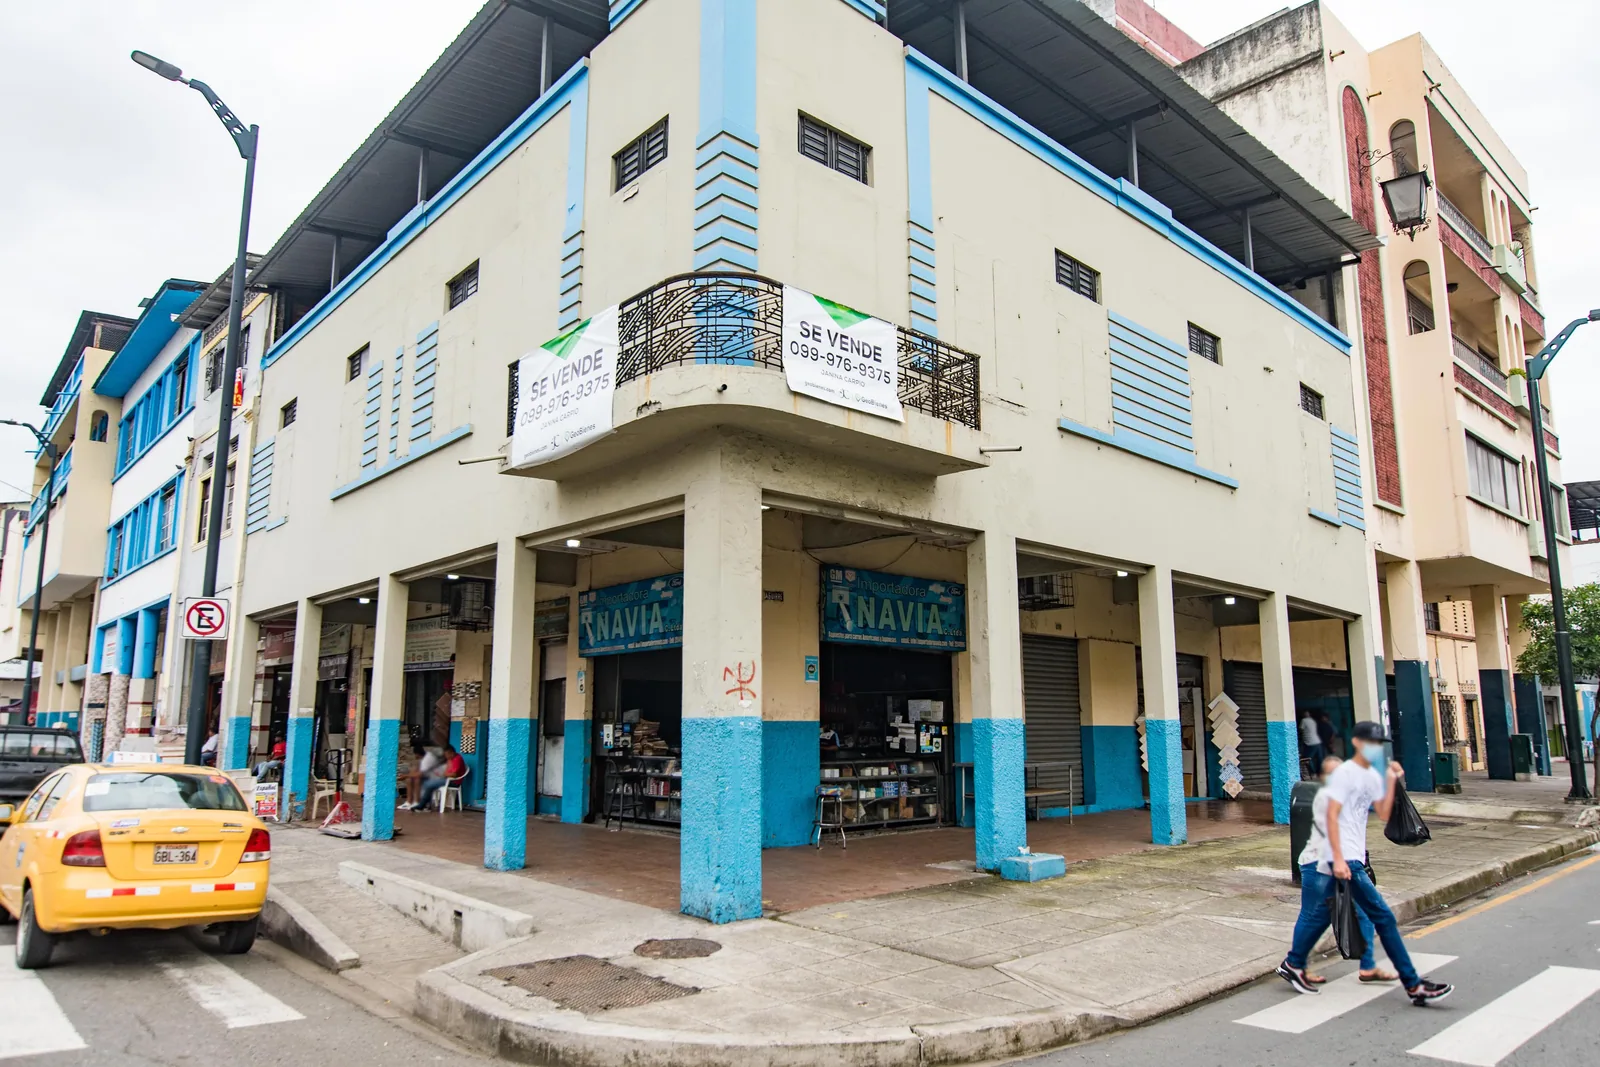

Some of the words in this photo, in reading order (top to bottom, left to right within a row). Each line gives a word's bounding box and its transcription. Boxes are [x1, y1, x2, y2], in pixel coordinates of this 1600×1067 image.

[800, 321, 822, 343] SE
[827, 329, 882, 363] VENDE
[531, 377, 548, 402] SE
[552, 348, 604, 392] VENDE
[790, 341, 891, 384] 099-976-9375
[520, 373, 610, 427] 099-976-9375
[830, 569, 842, 582] GM
[857, 577, 926, 597] Importadora
[197, 607, 214, 629] E
[596, 602, 664, 642] NAVIA
[857, 595, 943, 635] NAVIA
[154, 850, 197, 863] GBL-364
